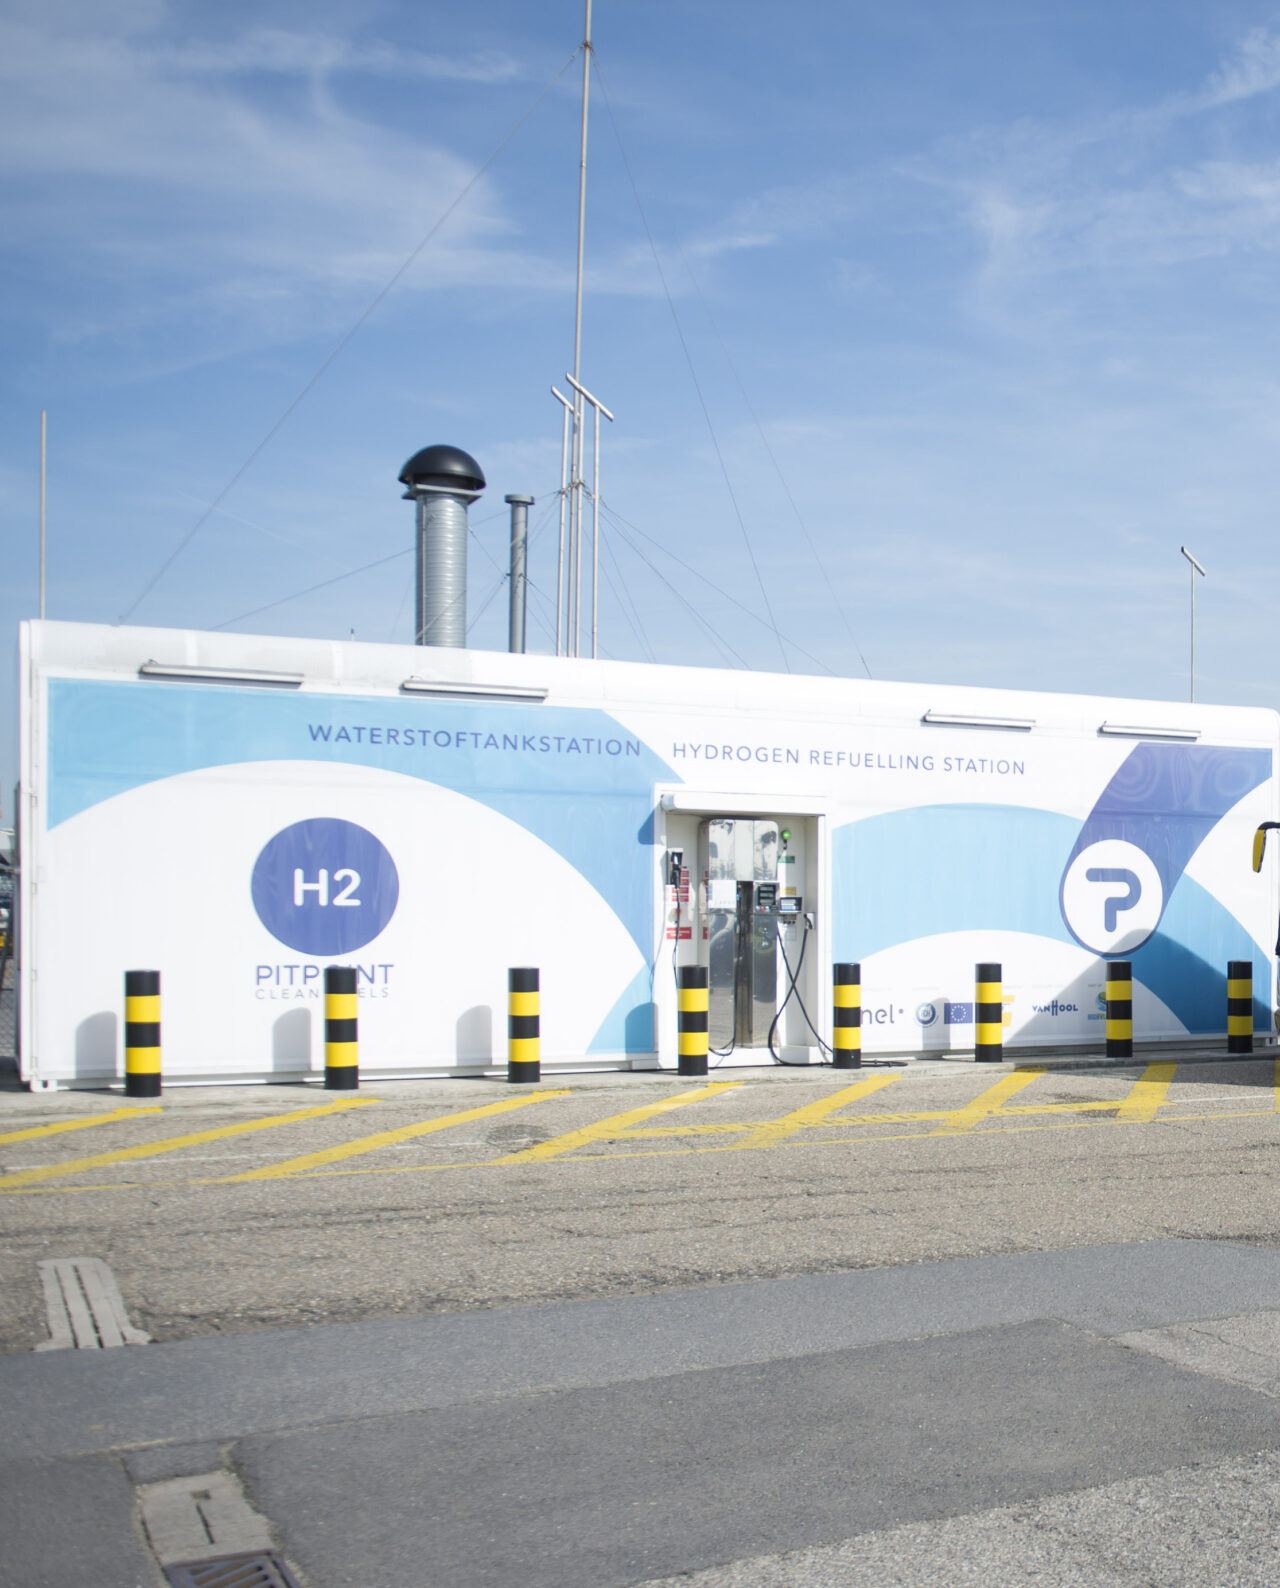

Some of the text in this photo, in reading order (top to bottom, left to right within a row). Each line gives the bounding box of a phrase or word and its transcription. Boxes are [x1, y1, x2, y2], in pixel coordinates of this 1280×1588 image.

[308, 723, 641, 757] WATERSTOFTANKSTATION
[673, 742, 1025, 776] HYDROGEN REFUELLING STATION
[294, 868, 362, 907] H2
[256, 964, 394, 986] PITPNT
[255, 988, 320, 1000] CLEAN
